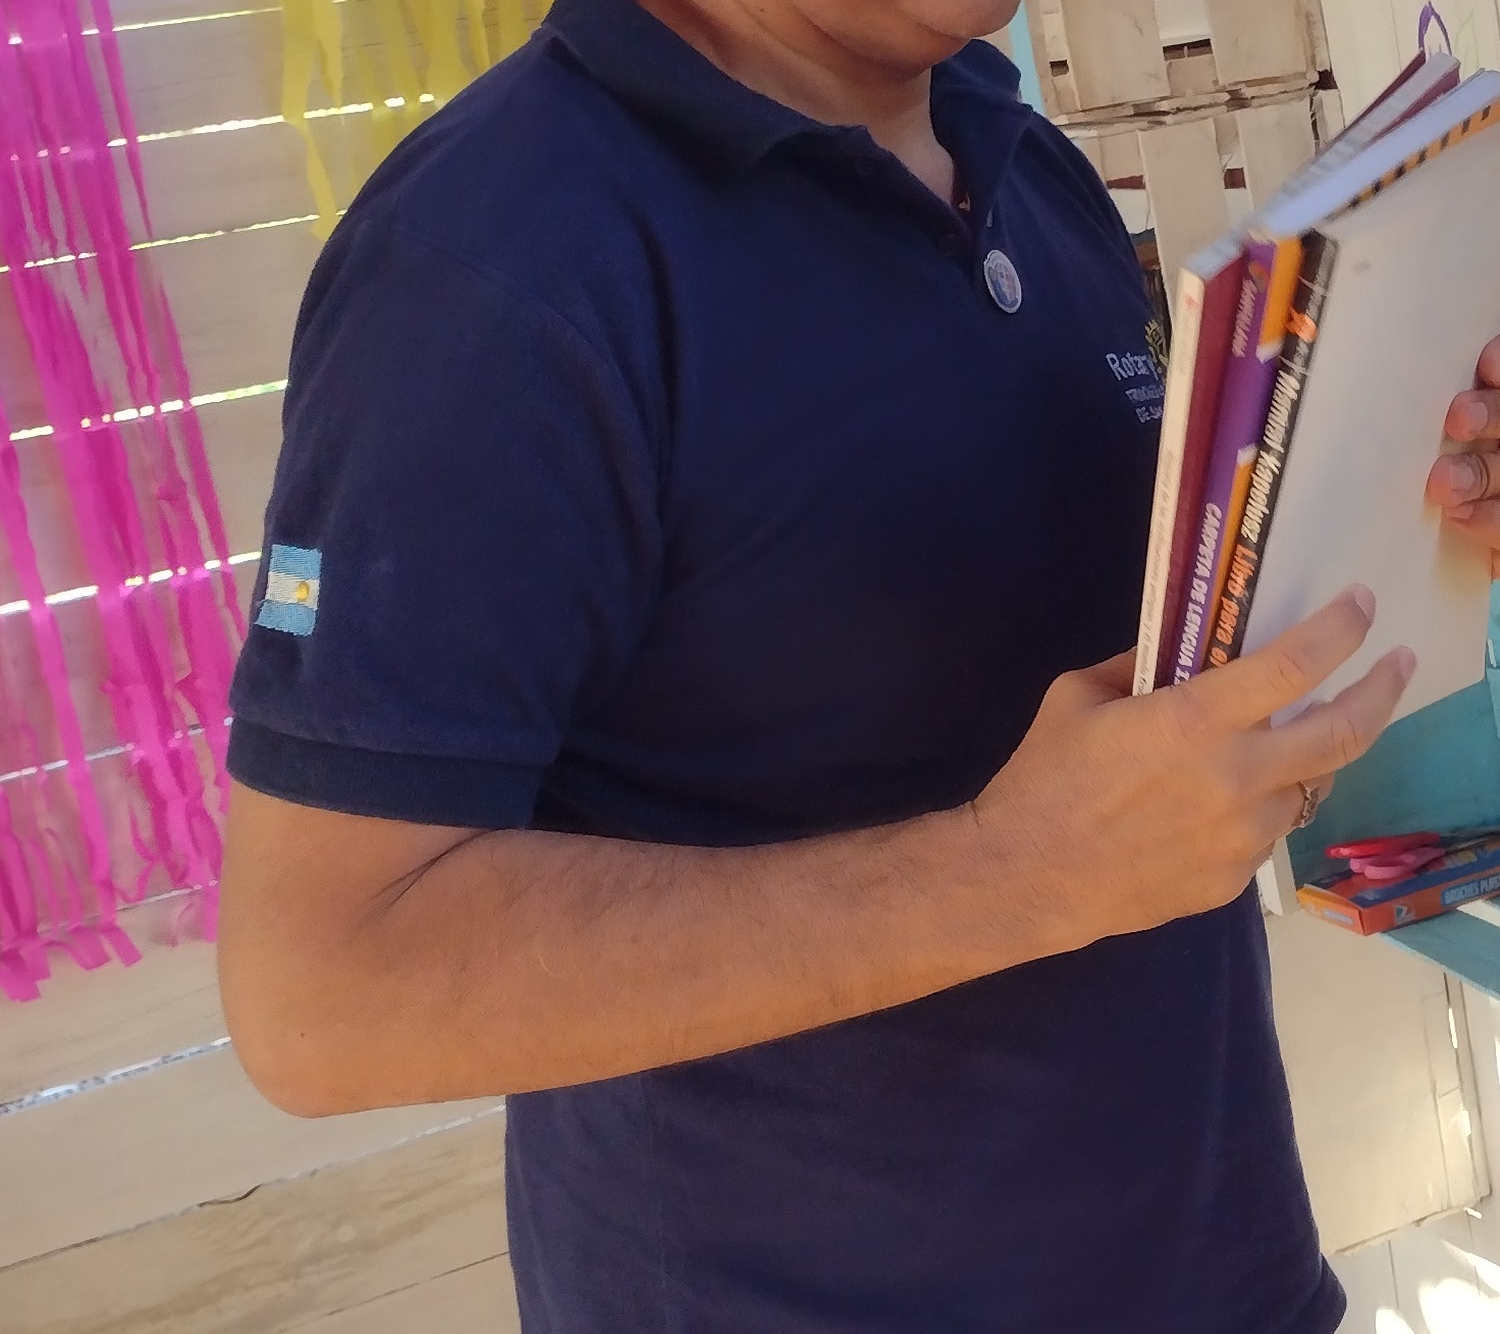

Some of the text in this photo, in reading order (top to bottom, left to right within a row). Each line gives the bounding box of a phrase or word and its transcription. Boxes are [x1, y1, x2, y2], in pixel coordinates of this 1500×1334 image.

[1241, 449, 1282, 543] Kapelusz
[1193, 502, 1223, 578] CARPETA
[1190, 576, 1209, 604] DE
[1227, 544, 1258, 598] Libro
[1177, 604, 1203, 668] LENGUA
[1216, 596, 1240, 645] para
